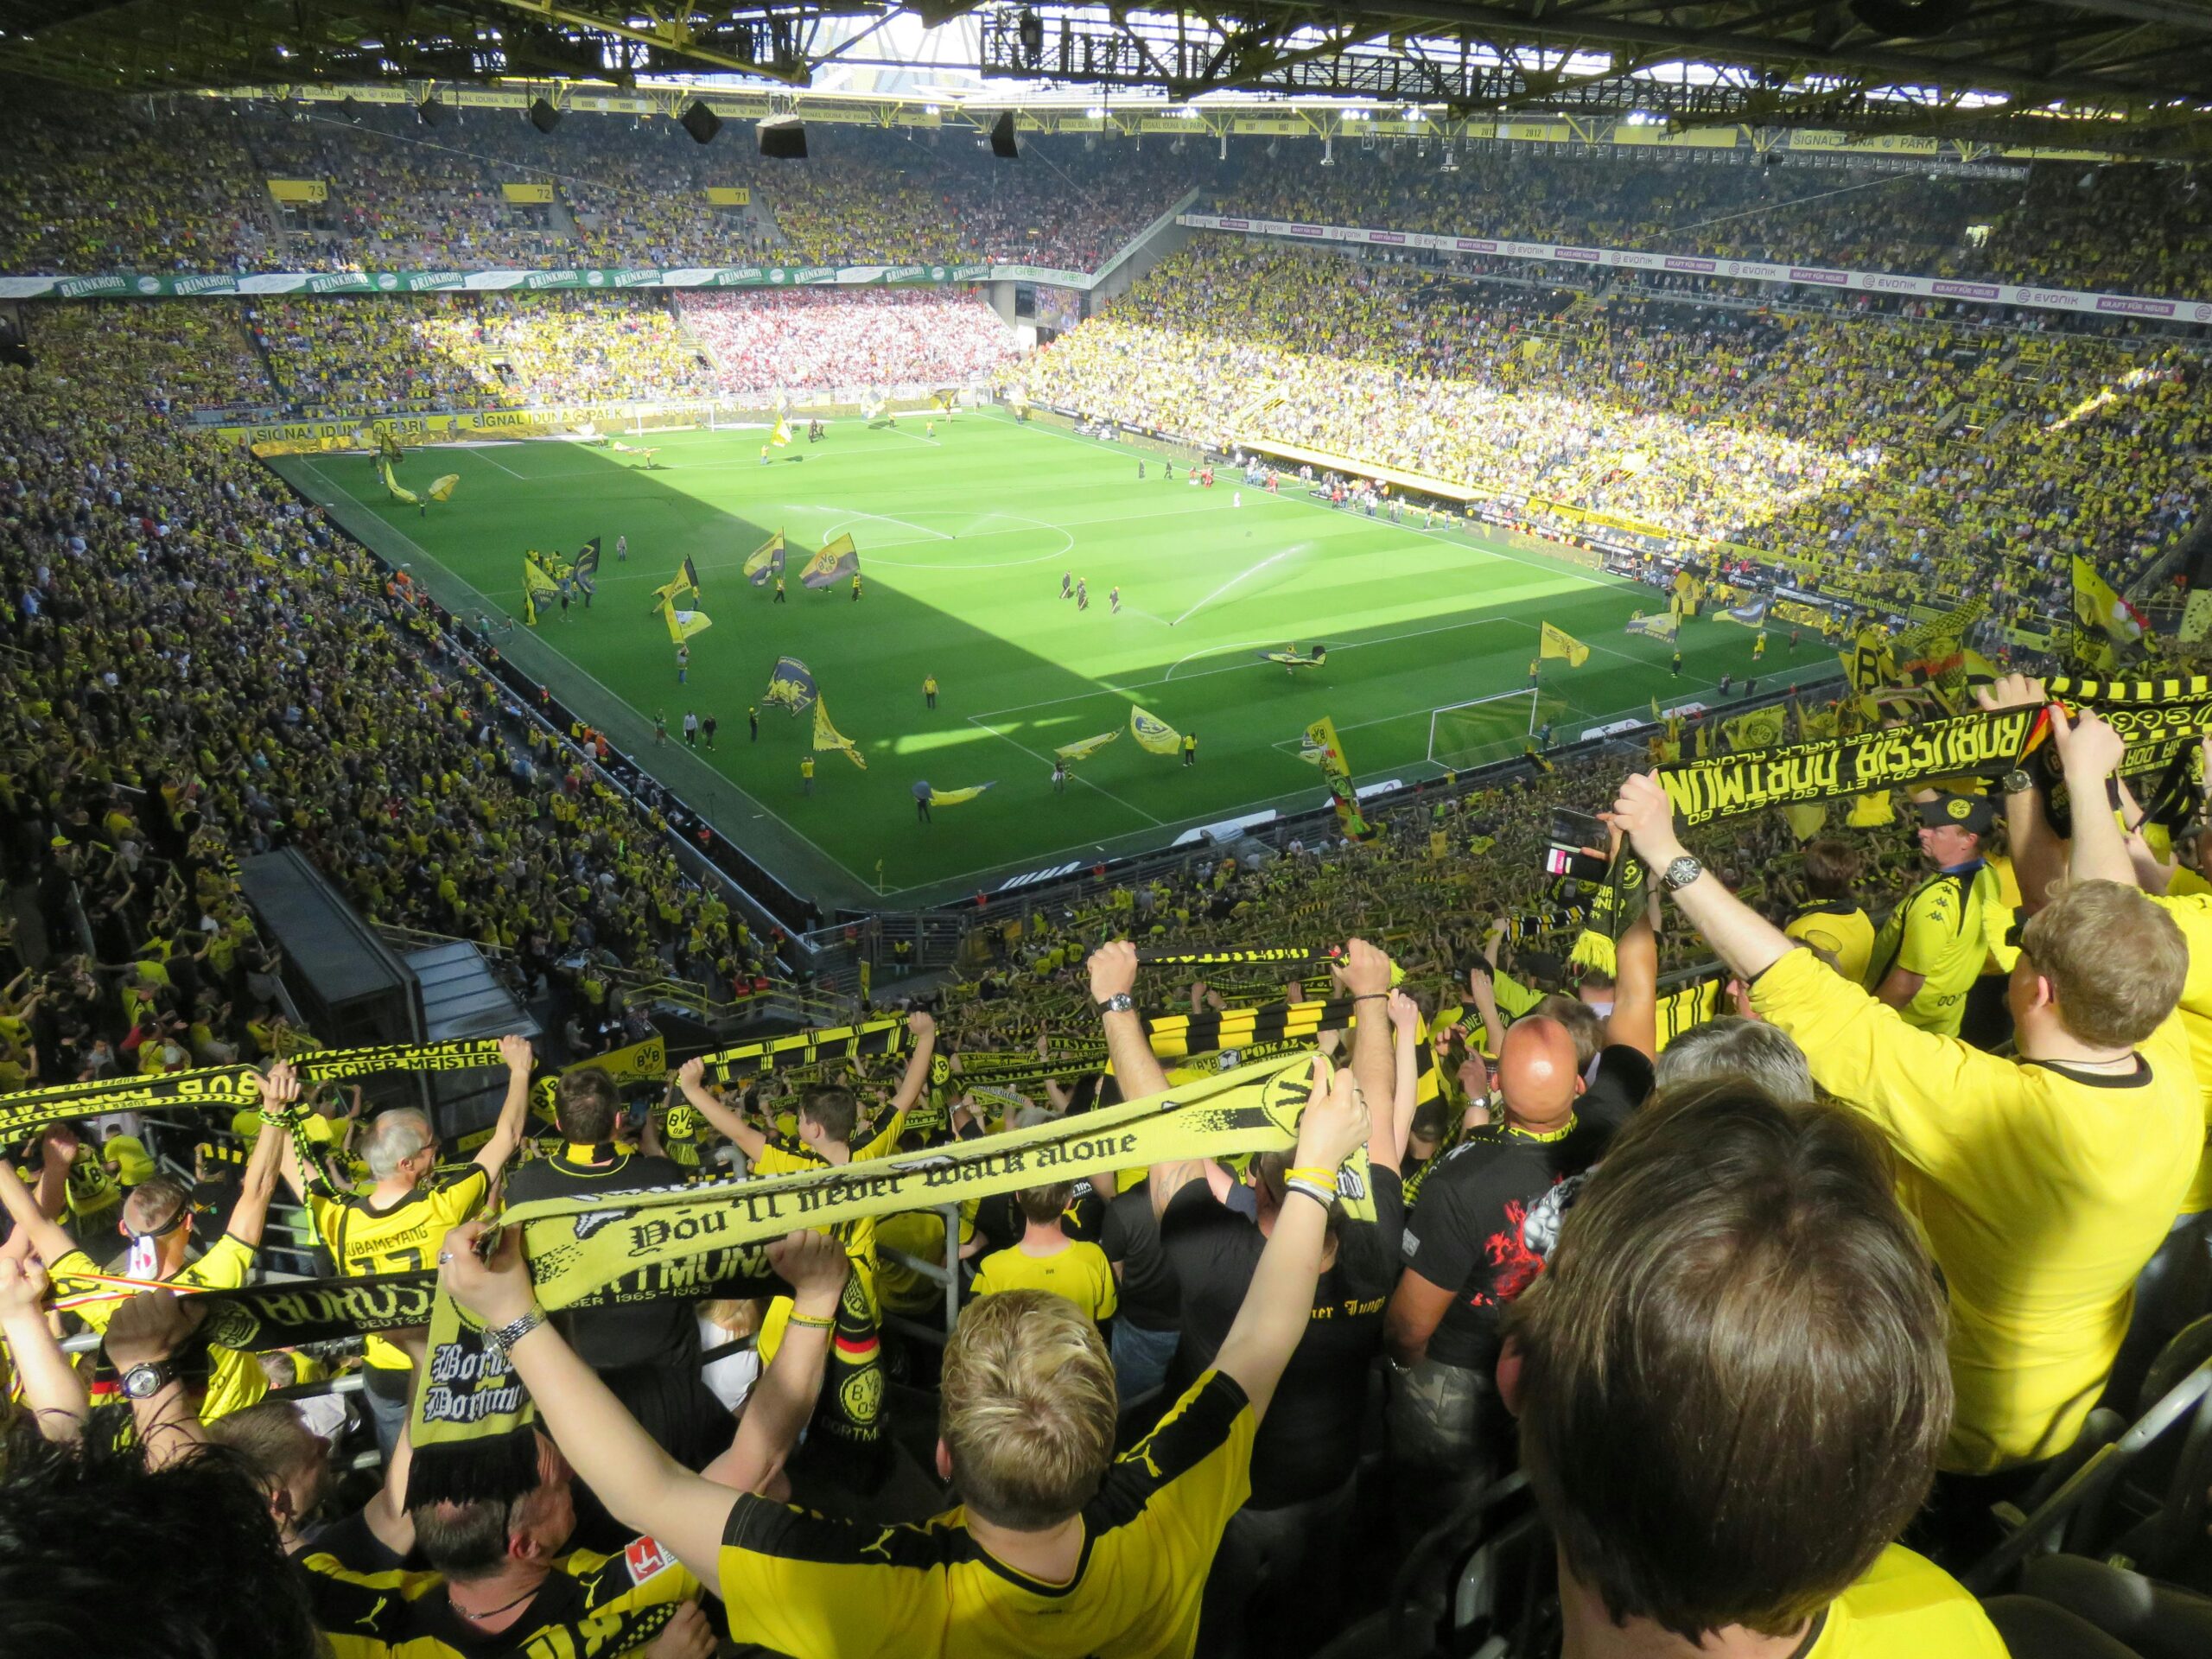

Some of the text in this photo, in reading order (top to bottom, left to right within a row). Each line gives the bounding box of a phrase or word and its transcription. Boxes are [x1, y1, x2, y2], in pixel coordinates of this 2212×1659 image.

[380, 92, 404, 100] PARK
[474, 95, 499, 104] IDUNA
[1900, 137, 1935, 149] PARK
[308, 185, 325, 197] 73
[537, 188, 550, 200] 72
[734, 191, 747, 202] 71
[1516, 245, 1545, 255] EVONIK
[1622, 255, 1653, 265] EVONIK
[1742, 266, 1777, 276] EVONIK
[1878, 278, 1916, 290] EVONIK
[2034, 294, 2079, 305] EVONIK
[2101, 300, 2126, 309] KRAFT
[2144, 303, 2170, 313] NEUES
[473, 414, 524, 428] SIGNAL
[1844, 725, 1915, 745] NEVER
[1777, 737, 1837, 760] WALK
[1659, 711, 2026, 817] BORUSSIA DORTMUN
[1690, 751, 1766, 769] ALONE
[1925, 760, 1980, 776] LET'S
[1687, 809, 1712, 826] GO
[1239, 1037, 1300, 1061] POKAL
[406, 1053, 500, 1071] MEISTER
[636, 1046, 662, 1068] BVB
[101, 1076, 138, 1087] SUPER
[112, 1098, 148, 1109] SUPER
[668, 1108, 694, 1132] BVB
[1037, 1131, 1138, 1168] alone
